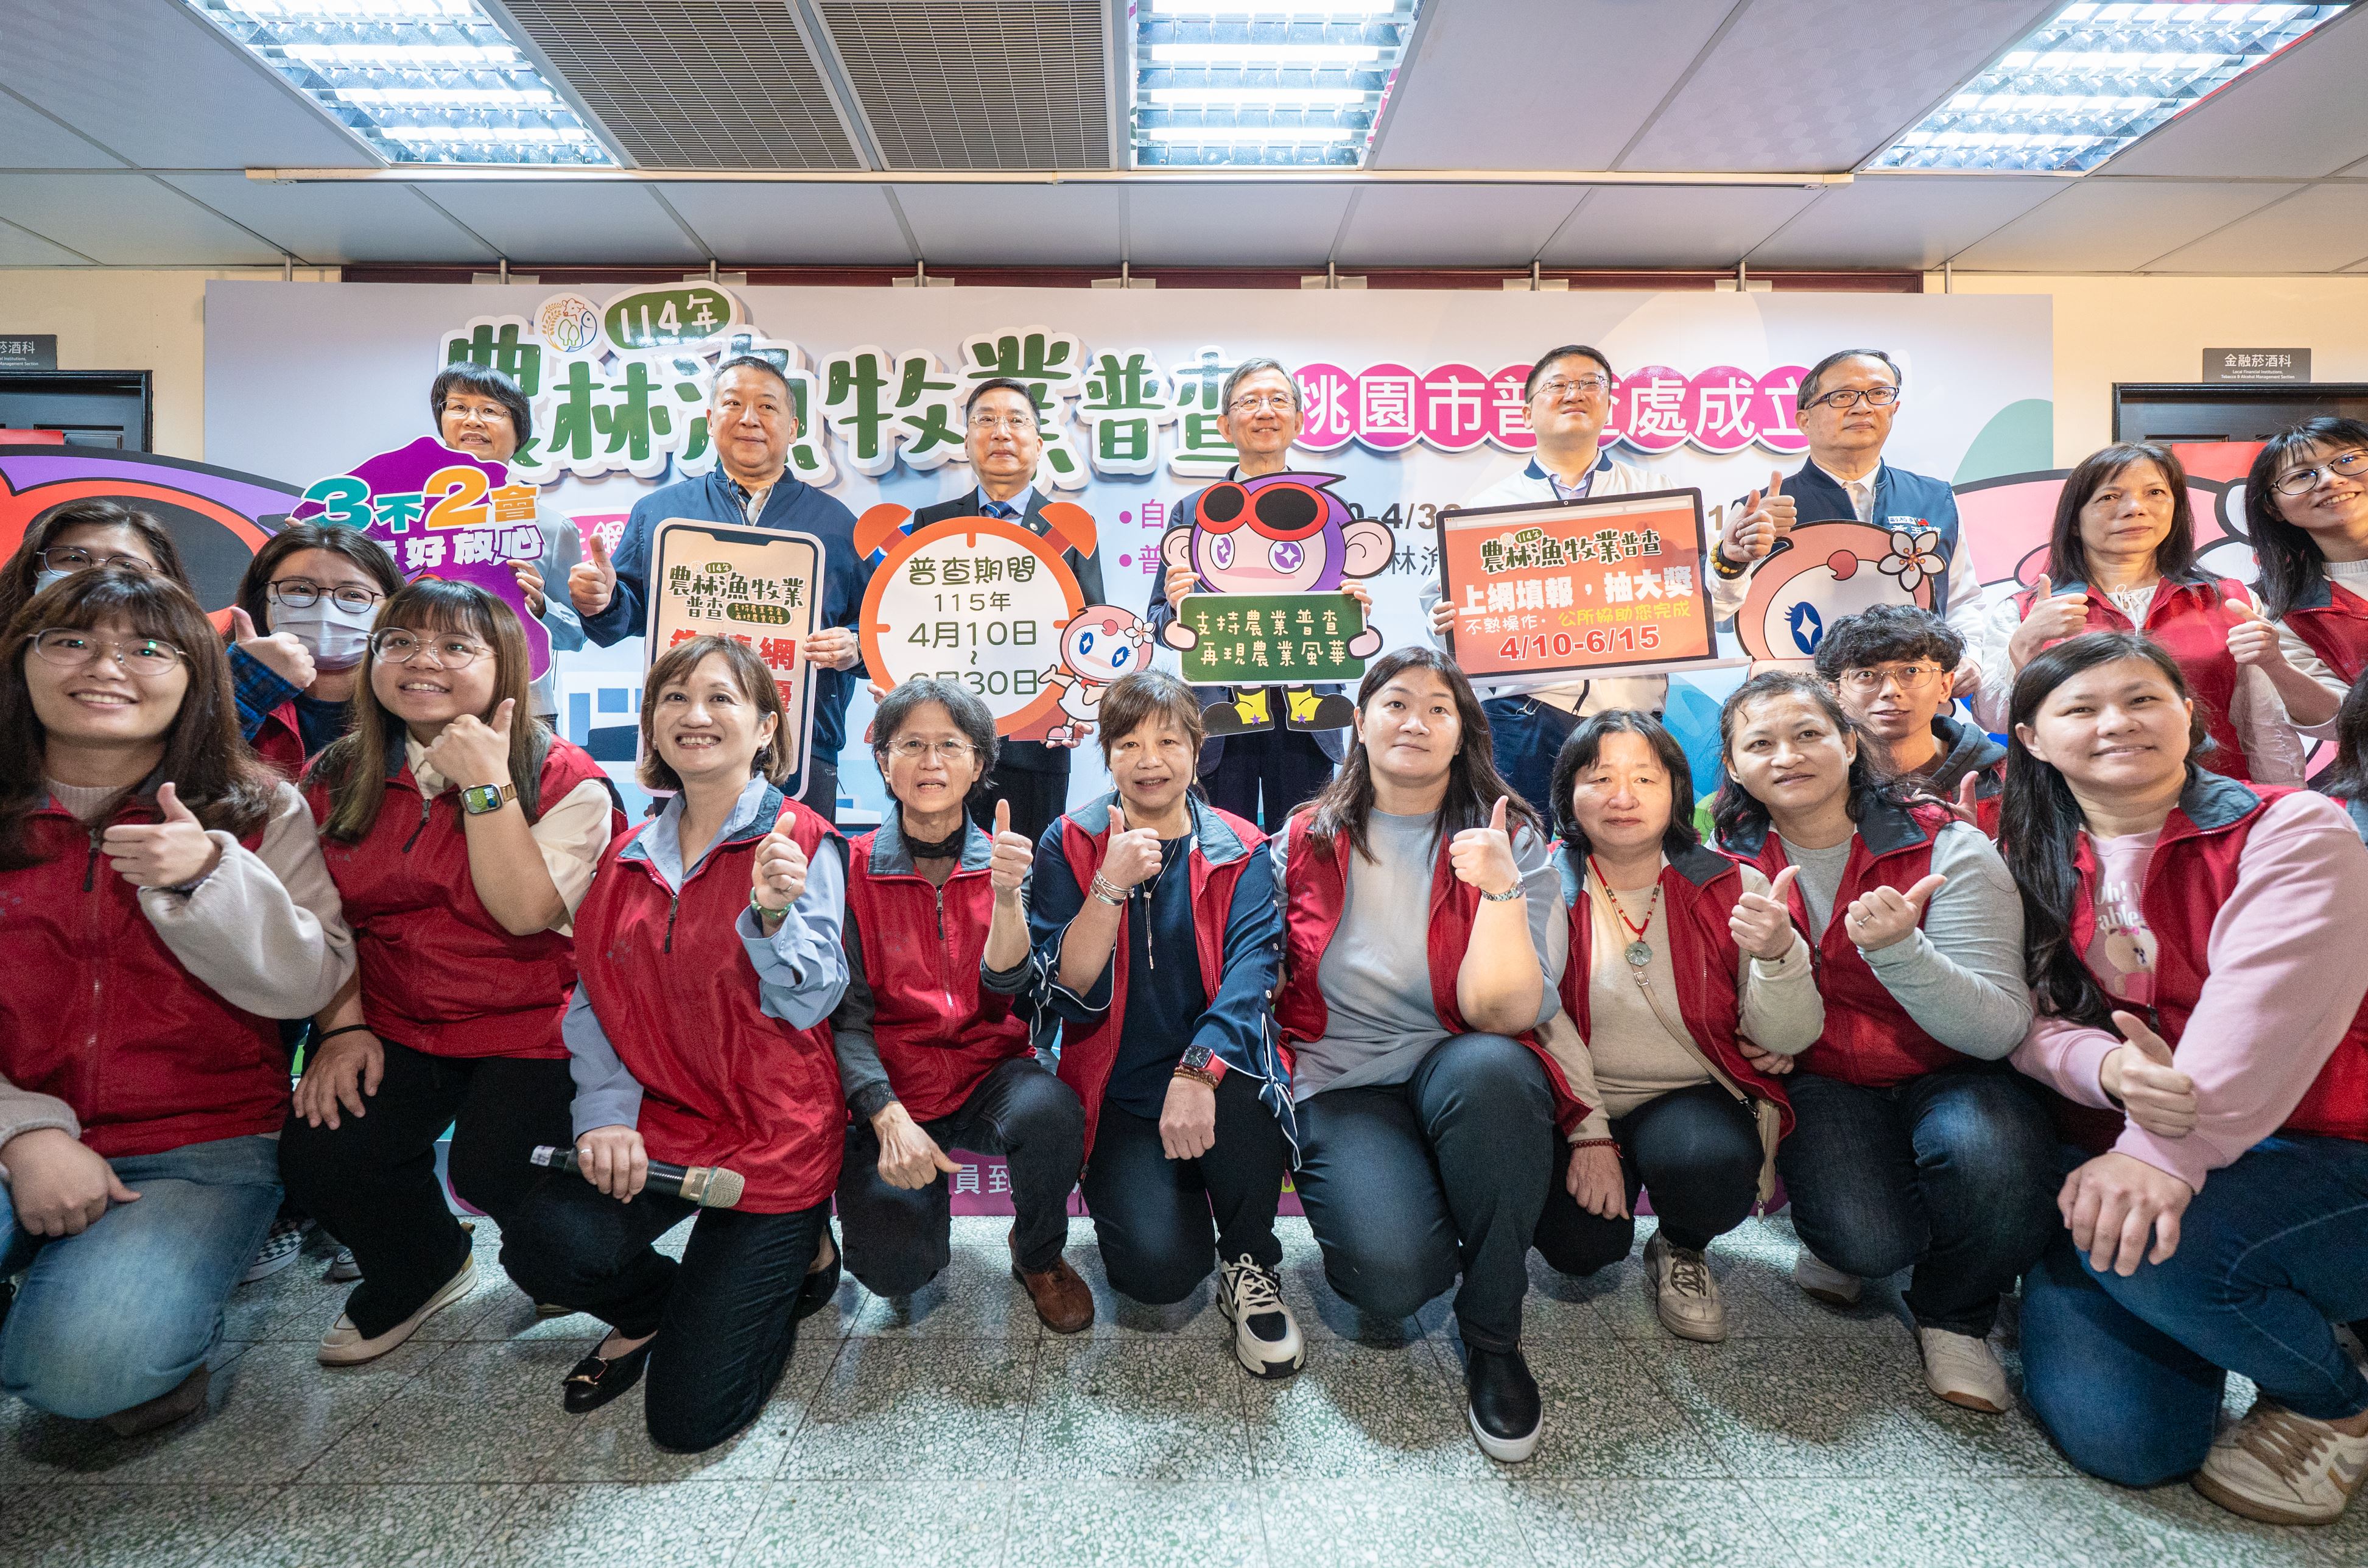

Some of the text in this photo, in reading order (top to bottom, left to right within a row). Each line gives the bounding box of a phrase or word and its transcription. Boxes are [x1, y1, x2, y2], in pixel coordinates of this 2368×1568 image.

[619, 292, 719, 342] 114年
[2224, 354, 2291, 367] 金融菸酒科
[1298, 374, 1804, 437] 桃園市普處成立
[304, 468, 538, 532] 3不2會
[1142, 499, 1164, 529] 自
[1348, 502, 1461, 530] -4/3
[1482, 530, 1662, 572] 農林漁牧業普查
[1517, 530, 1541, 542] 114年
[908, 555, 1036, 585] 普查期間
[669, 564, 803, 608] 農林漁牧業
[1459, 565, 1695, 616] 上網填報，抽大獎
[686, 596, 723, 621] 普查
[934, 591, 1011, 612] 115年
[1558, 600, 1692, 627] 公所協助您完成
[907, 619, 1037, 649] 4月10日
[1196, 609, 1338, 636] 支持農業普查
[1200, 639, 1346, 667] 再現農業風華
[1498, 624, 1661, 661] 4/10-6/15
[909, 669, 1038, 695] 30日
